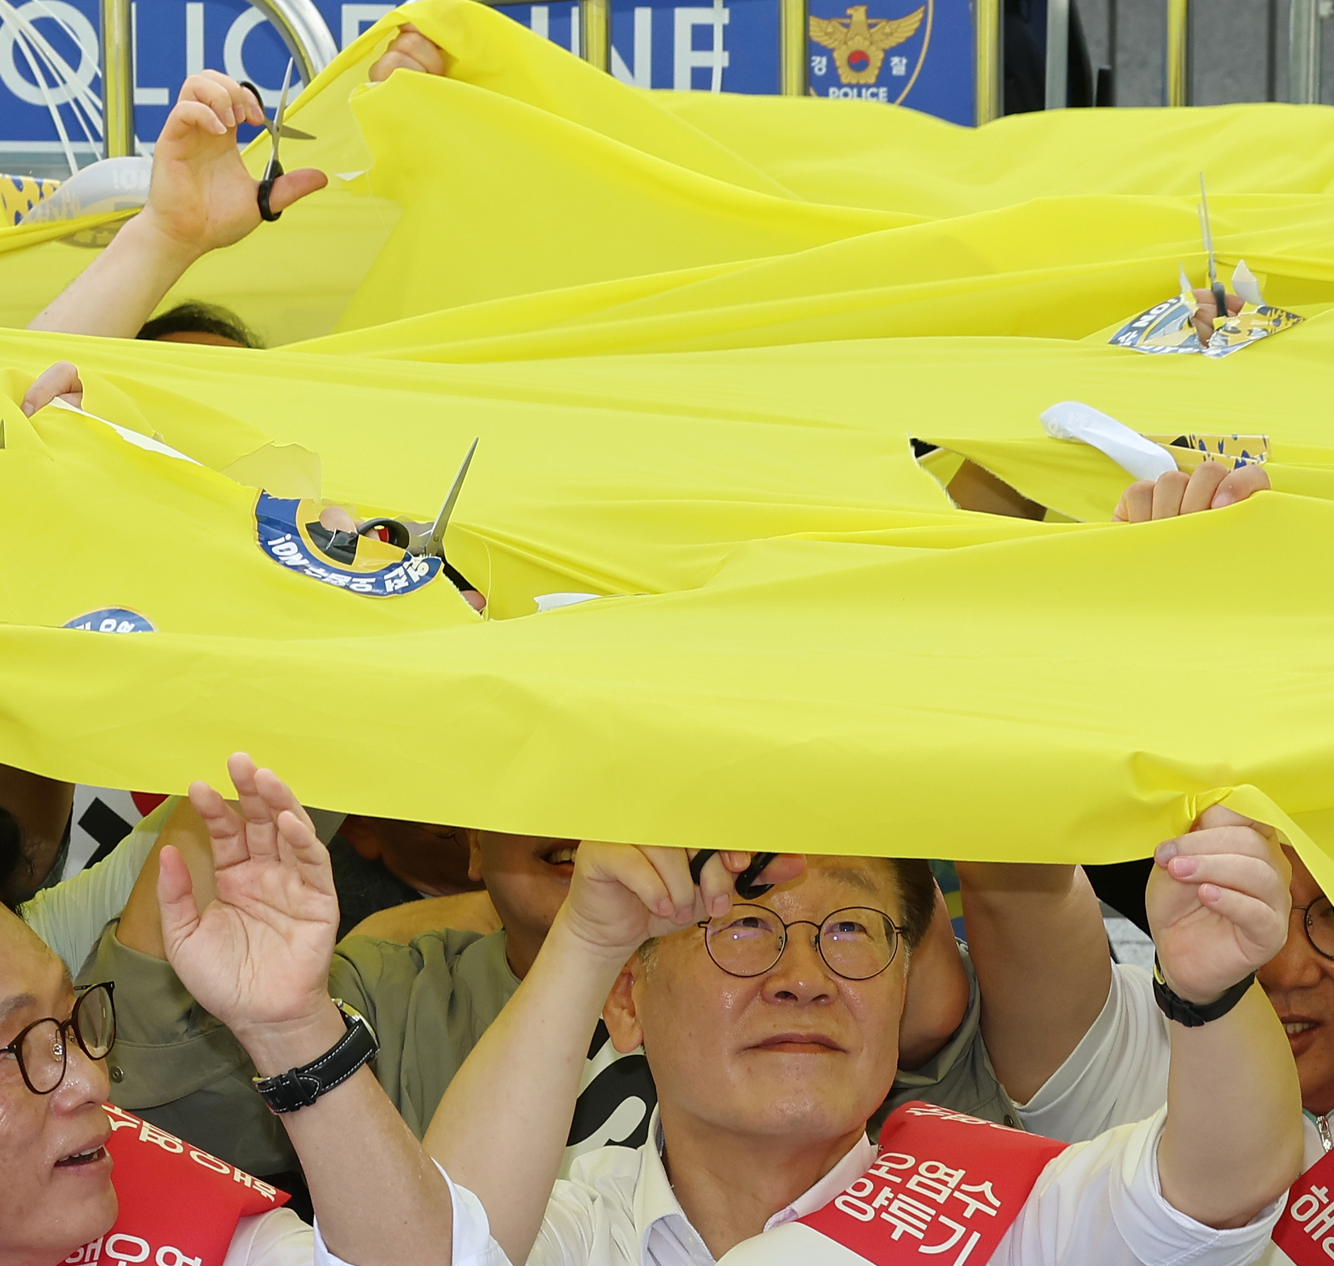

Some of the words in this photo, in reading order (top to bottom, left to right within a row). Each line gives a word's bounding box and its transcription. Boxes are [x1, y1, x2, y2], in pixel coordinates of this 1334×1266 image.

[810, 55, 828, 77] 경
[890, 56, 908, 77] 찰
[828, 87, 889, 103] POLICE
[267, 533, 310, 567] NO!
[868, 1152, 1002, 1219] 오염수
